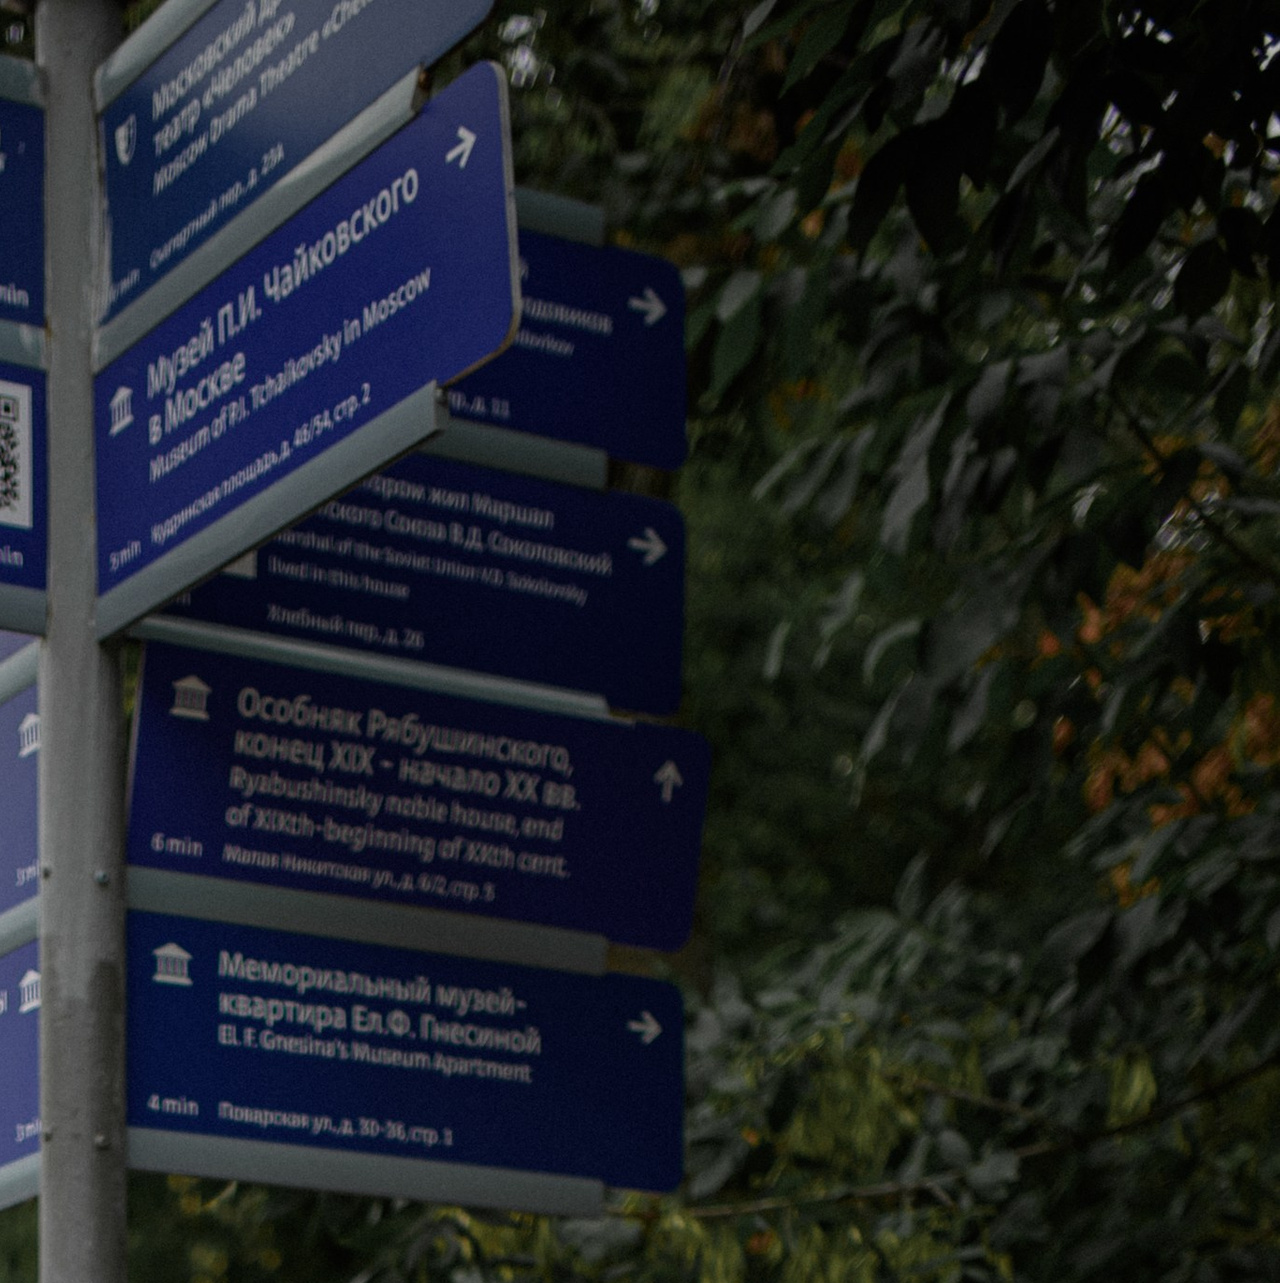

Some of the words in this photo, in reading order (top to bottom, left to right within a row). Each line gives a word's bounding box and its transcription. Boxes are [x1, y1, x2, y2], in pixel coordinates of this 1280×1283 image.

[148, 317, 215, 397] Музей
[217, 286, 262, 344] П.И.
[263, 169, 420, 300] Чайковского
[148, 414, 163, 444] в
[165, 352, 247, 432] Москве
[149, 424, 211, 482] Museum
[250, 329, 343, 409] Tchaikovsky
[344, 317, 361, 345] in
[362, 267, 432, 332] Moscow
[237, 688, 363, 736] Особняк
[366, 708, 575, 777] Рябушинского,
[233, 729, 325, 772] конец
[327, 741, 376, 775] XIX
[399, 758, 500, 797] начало
[502, 770, 541, 803] XX
[151, 833, 167, 853] 6
[167, 834, 203, 857] min
[224, 803, 252, 827] of
[218, 951, 432, 1002] Мемориальный
[435, 985, 527, 1016] музей-
[218, 992, 347, 1032] квартира
[420, 1014, 542, 1054] Гнесиной
[352, 1042, 431, 1068] Museum
[433, 1053, 533, 1083] Apartment
[162, 1097, 200, 1116] min
